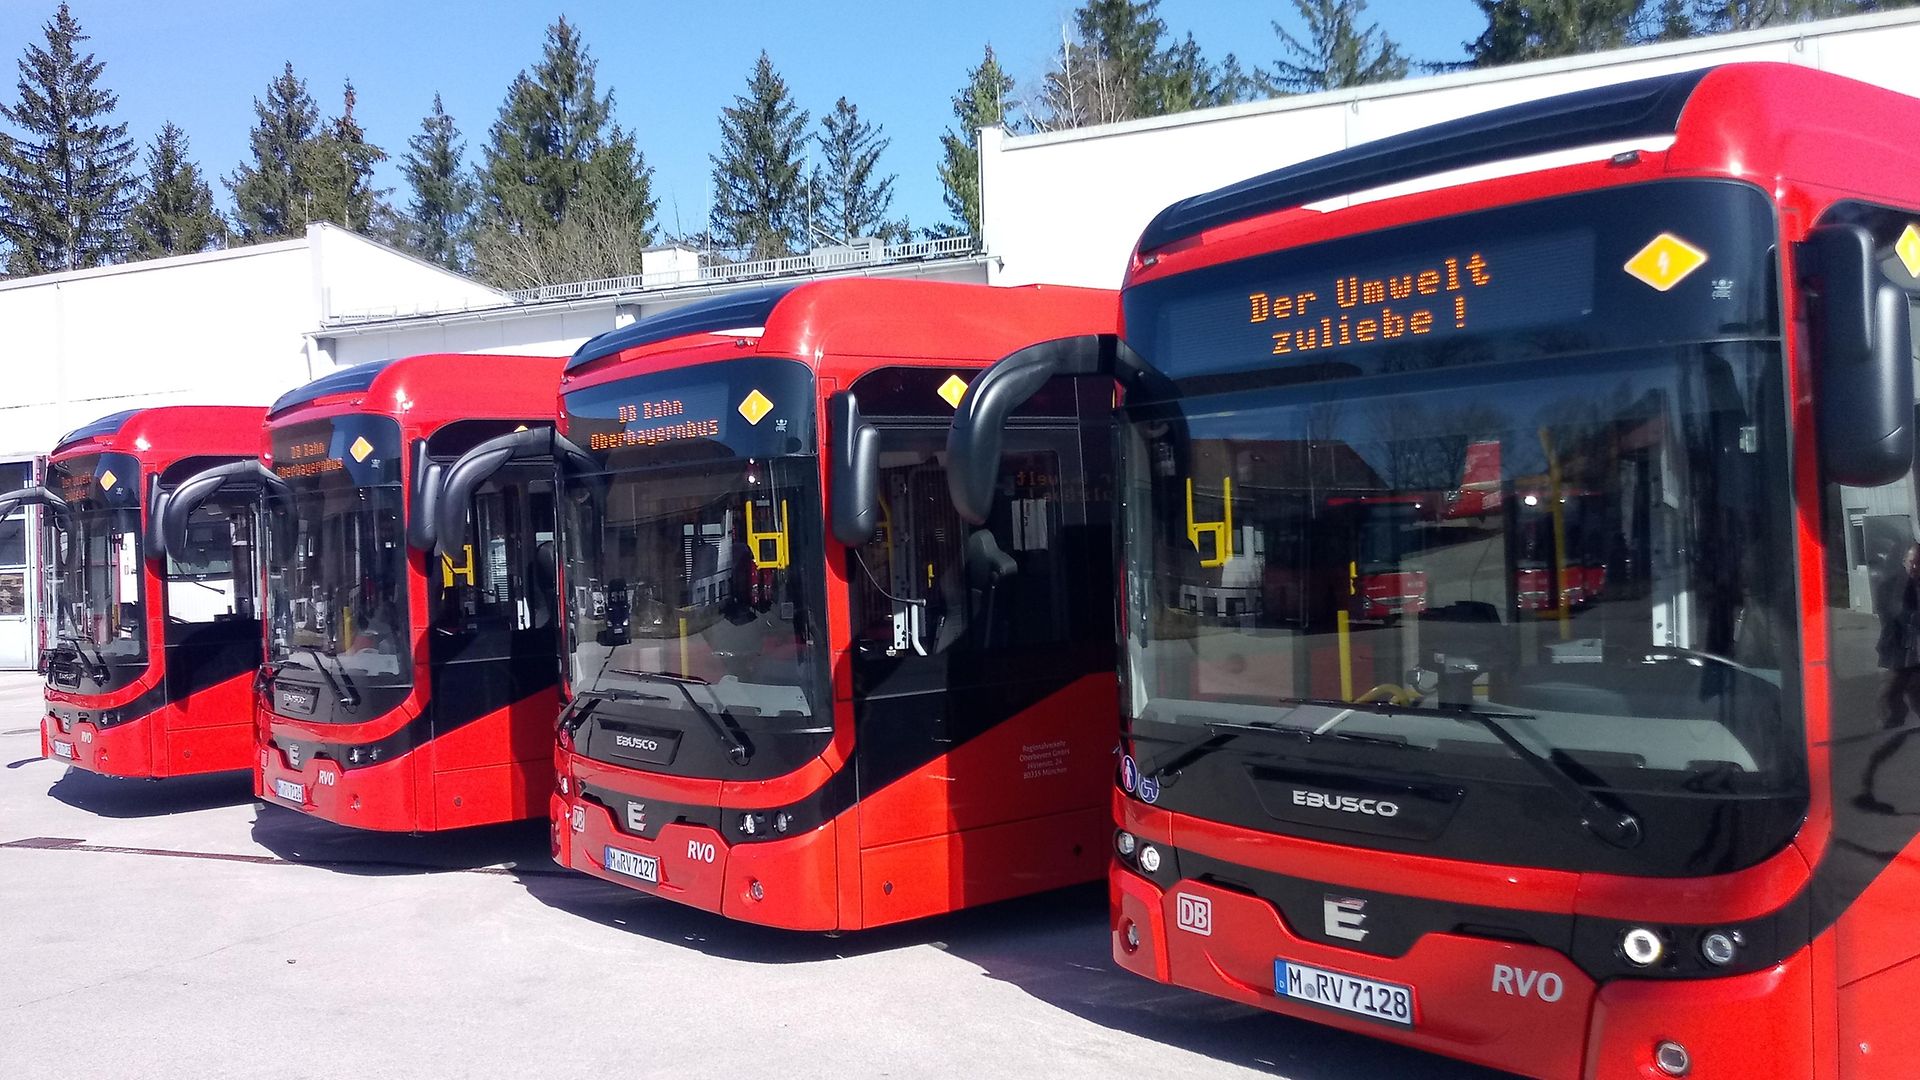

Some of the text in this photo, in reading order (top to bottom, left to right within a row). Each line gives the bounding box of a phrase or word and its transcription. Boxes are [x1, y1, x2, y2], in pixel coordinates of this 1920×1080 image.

[1249, 252, 1491, 324] Der Umwelt
[1272, 308, 1433, 355] zuliebe
[618, 399, 683, 423] DB Bahn
[304, 441, 325, 457] Bahn
[590, 419, 719, 450] Oberbayernbus
[616, 735, 658, 751] EBUSCO
[318, 769, 335, 786] RVO
[627, 800, 647, 832] E
[1292, 790, 1399, 818] EBUSCO
[620, 853, 632, 872] RV
[632, 856, 655, 879] 7127
[687, 840, 716, 864] RVO
[1180, 897, 1209, 929] DB
[1324, 892, 1370, 943] E
[1288, 966, 1408, 1019] M RV 7128
[1491, 963, 1563, 1003] RVO
